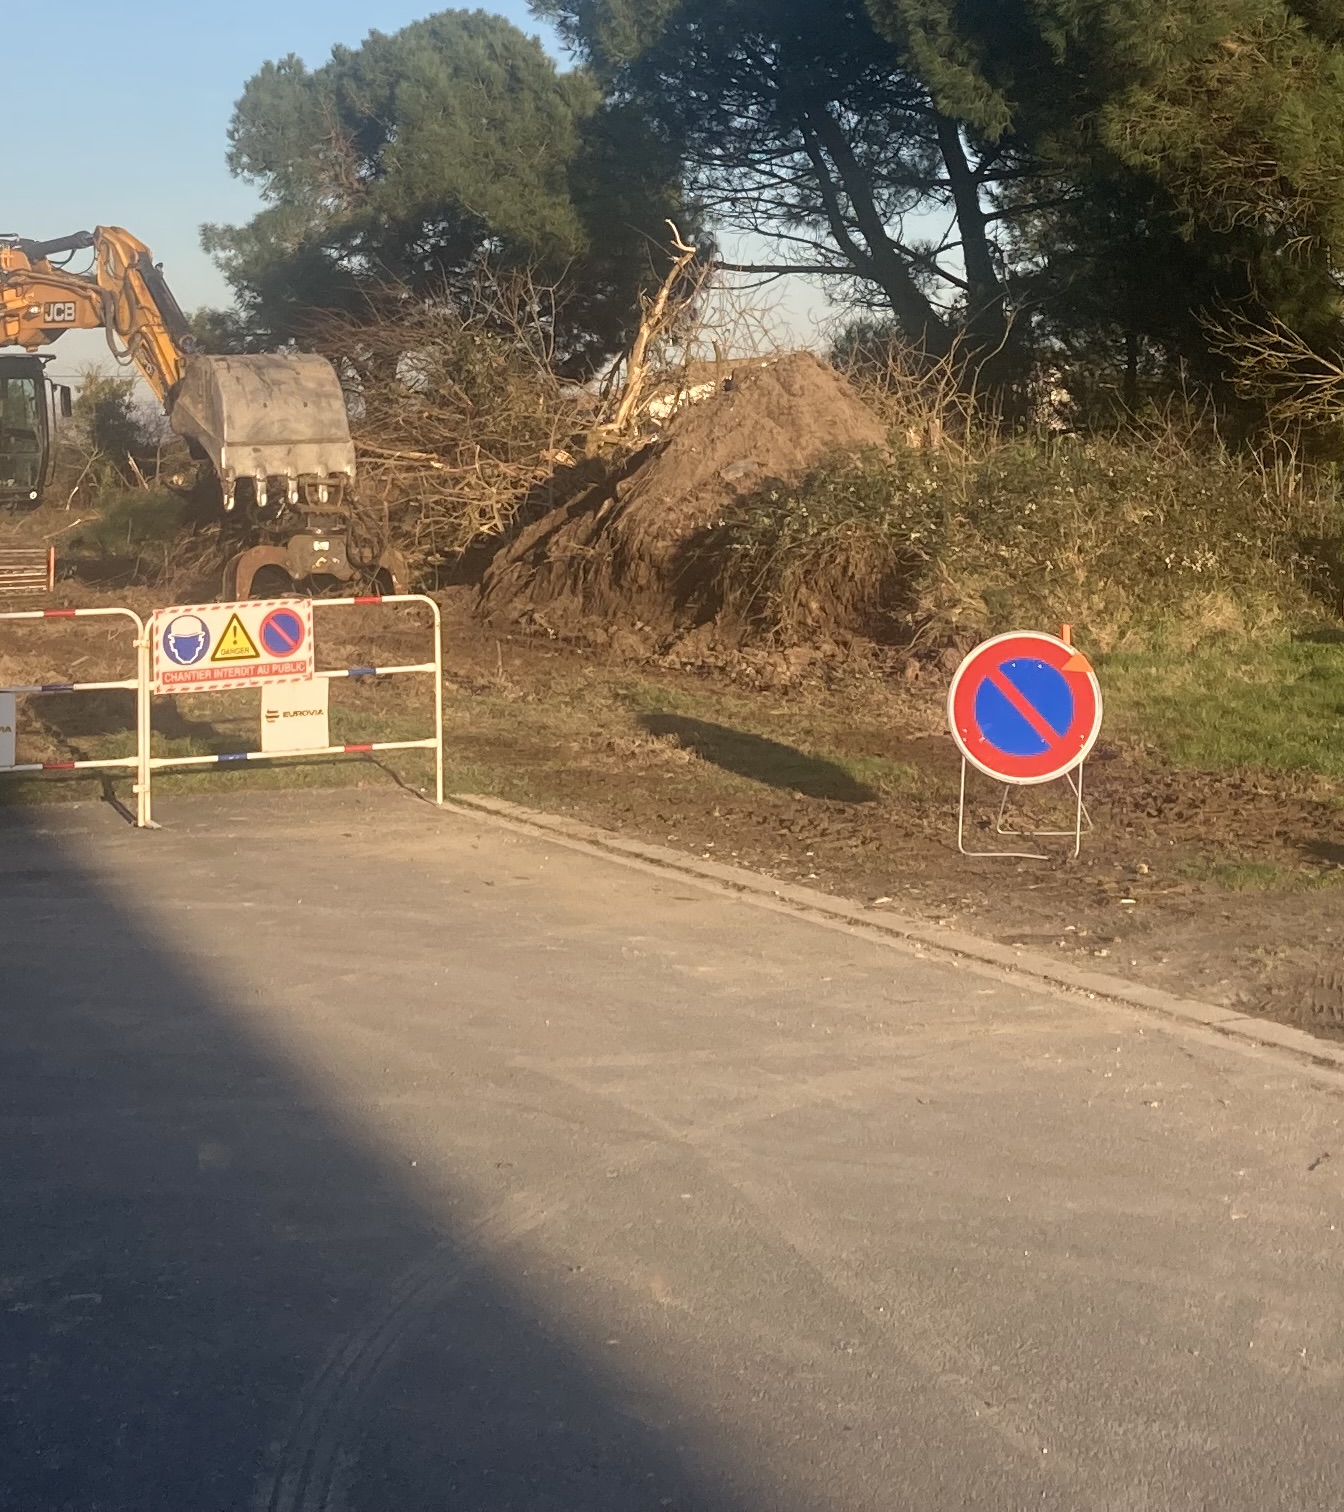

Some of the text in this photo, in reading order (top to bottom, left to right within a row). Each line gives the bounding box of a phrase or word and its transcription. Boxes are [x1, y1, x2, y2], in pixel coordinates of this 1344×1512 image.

[45, 303, 75, 322] JCB
[164, 661, 305, 683] CHANTIER INTERDIT AU PUBLIC
[282, 709, 325, 718] EUROVIA
